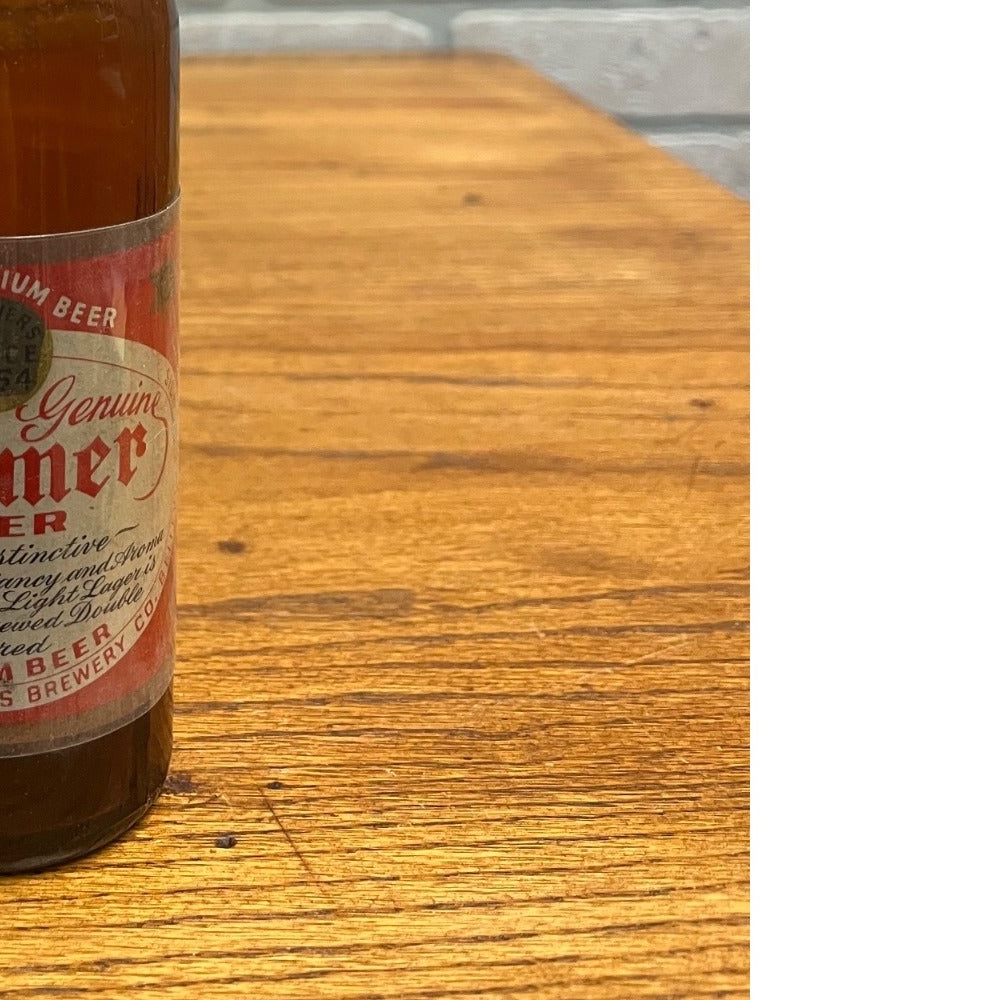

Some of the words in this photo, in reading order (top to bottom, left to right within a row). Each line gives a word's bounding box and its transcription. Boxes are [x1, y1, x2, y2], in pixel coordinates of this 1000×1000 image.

[52, 295, 117, 329] BEER
[15, 375, 164, 443] Genuine
[65, 552, 114, 583] and
[110, 529, 165, 568] Aroma
[0, 585, 81, 619] Light
[80, 567, 143, 602] Lager
[144, 554, 156, 575] is
[63, 583, 145, 628] Double
[26, 623, 111, 677] BEER
[27, 635, 125, 704] BREWERY
